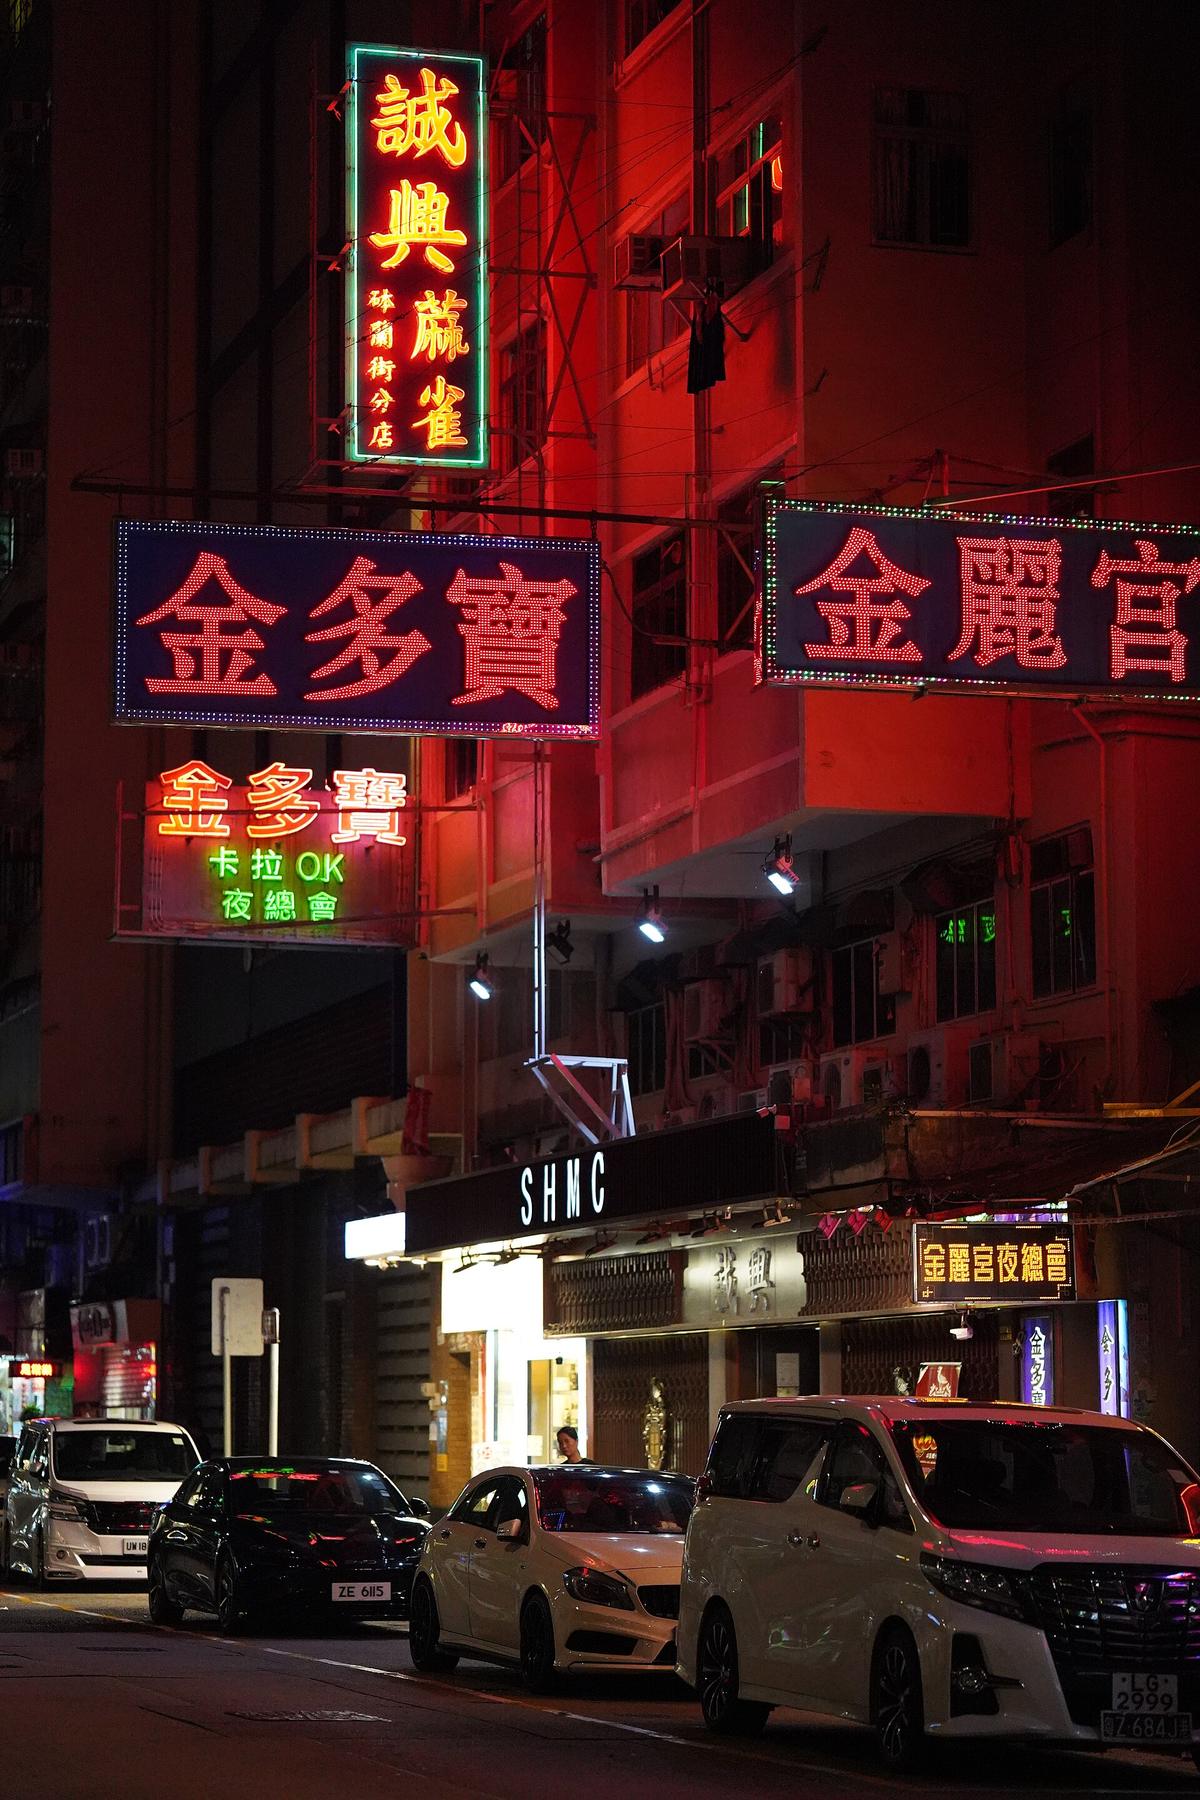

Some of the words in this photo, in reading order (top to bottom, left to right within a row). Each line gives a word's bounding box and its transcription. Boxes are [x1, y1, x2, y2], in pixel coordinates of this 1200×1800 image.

[136, 551, 578, 711] 金多寶
[158, 760, 407, 847] 金多寶
[221, 888, 338, 923] 夜總會
[520, 1151, 606, 1226] SHMC
[923, 1242, 1067, 1283] 金麗宮夜總會
[1100, 1325, 1115, 1415] 金多
[338, 1586, 355, 1598] ZE
[361, 1586, 384, 1598] 6115
[1117, 1692, 1174, 1711] 2999
[1131, 1675, 1160, 1692] LG
